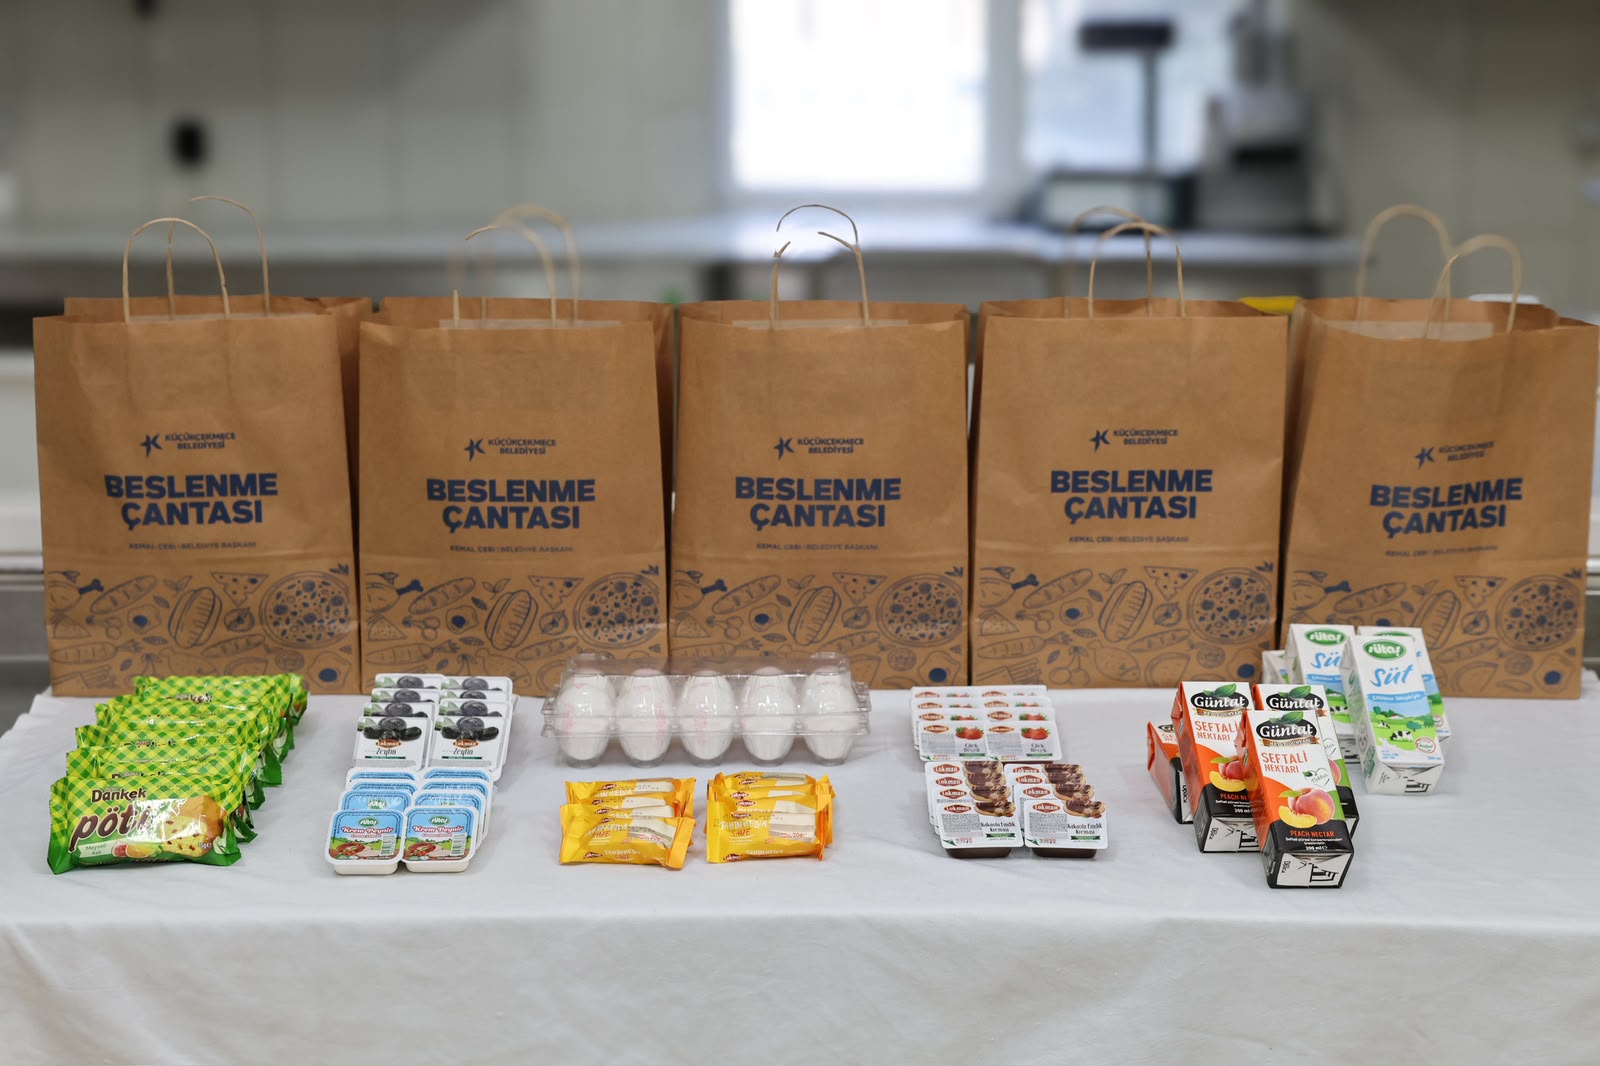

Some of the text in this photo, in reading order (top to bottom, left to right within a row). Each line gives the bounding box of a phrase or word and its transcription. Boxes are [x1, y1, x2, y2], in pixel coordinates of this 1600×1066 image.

[104, 473, 278, 499] BESLENME
[427, 478, 596, 503] BESLENME
[735, 476, 902, 501] BESLENME
[1051, 469, 1213, 493] BESLENME
[1370, 477, 1523, 509] BESLENME
[121, 500, 263, 530] ÇANTASI
[442, 505, 580, 534] ÇANTASI
[750, 503, 886, 532] ÇANTASI
[1064, 495, 1197, 525] ÇANTASI
[1382, 504, 1506, 539] ÇANTASI
[1310, 651, 1342, 669] Sü
[1370, 664, 1414, 687] Süt
[1194, 696, 1246, 708] Güntat
[1269, 697, 1320, 709] Güntat
[1260, 724, 1313, 737] Güntat
[91, 788, 147, 803] Dankek
